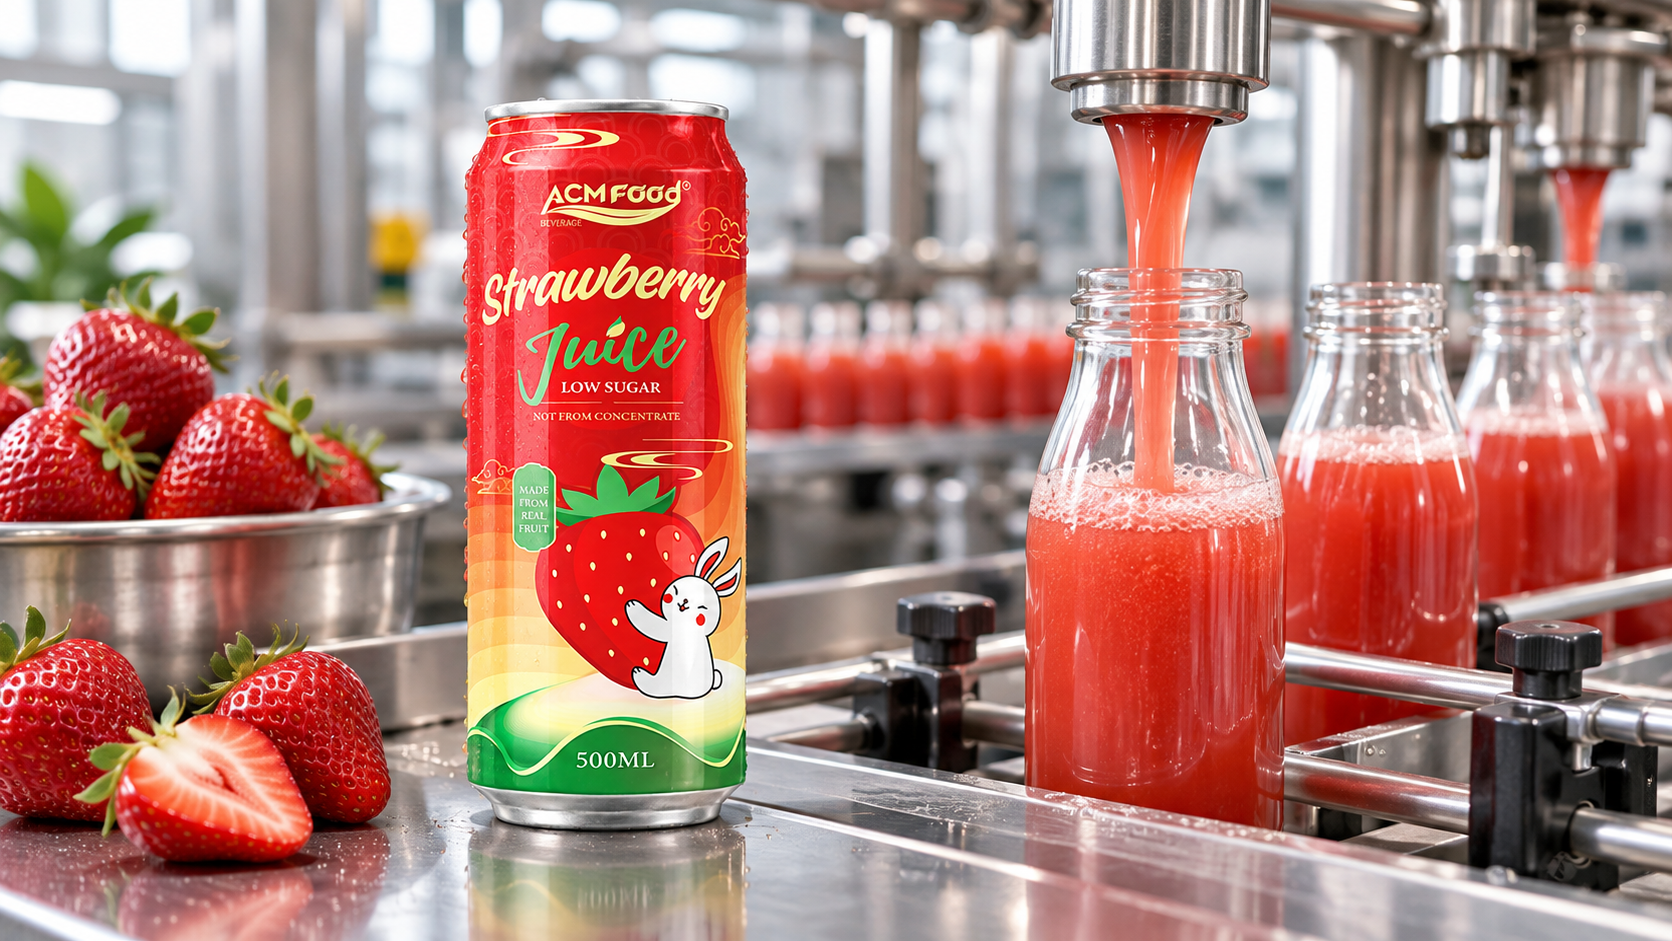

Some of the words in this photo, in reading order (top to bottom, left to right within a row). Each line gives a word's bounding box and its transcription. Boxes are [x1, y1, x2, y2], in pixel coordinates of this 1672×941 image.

[540, 219, 582, 228] BEVERAGE
[482, 253, 726, 326] Strawberry
[517, 316, 687, 407] Juice
[561, 381, 601, 394] LOW
[604, 381, 661, 394] SUGAR
[533, 412, 557, 421] NOT
[594, 412, 681, 421] CONCENTRATE
[519, 486, 549, 494] MADE
[519, 499, 548, 507] FROM
[521, 511, 547, 520] REAL
[519, 524, 549, 533] FRUIT
[576, 751, 655, 769] 500ML
